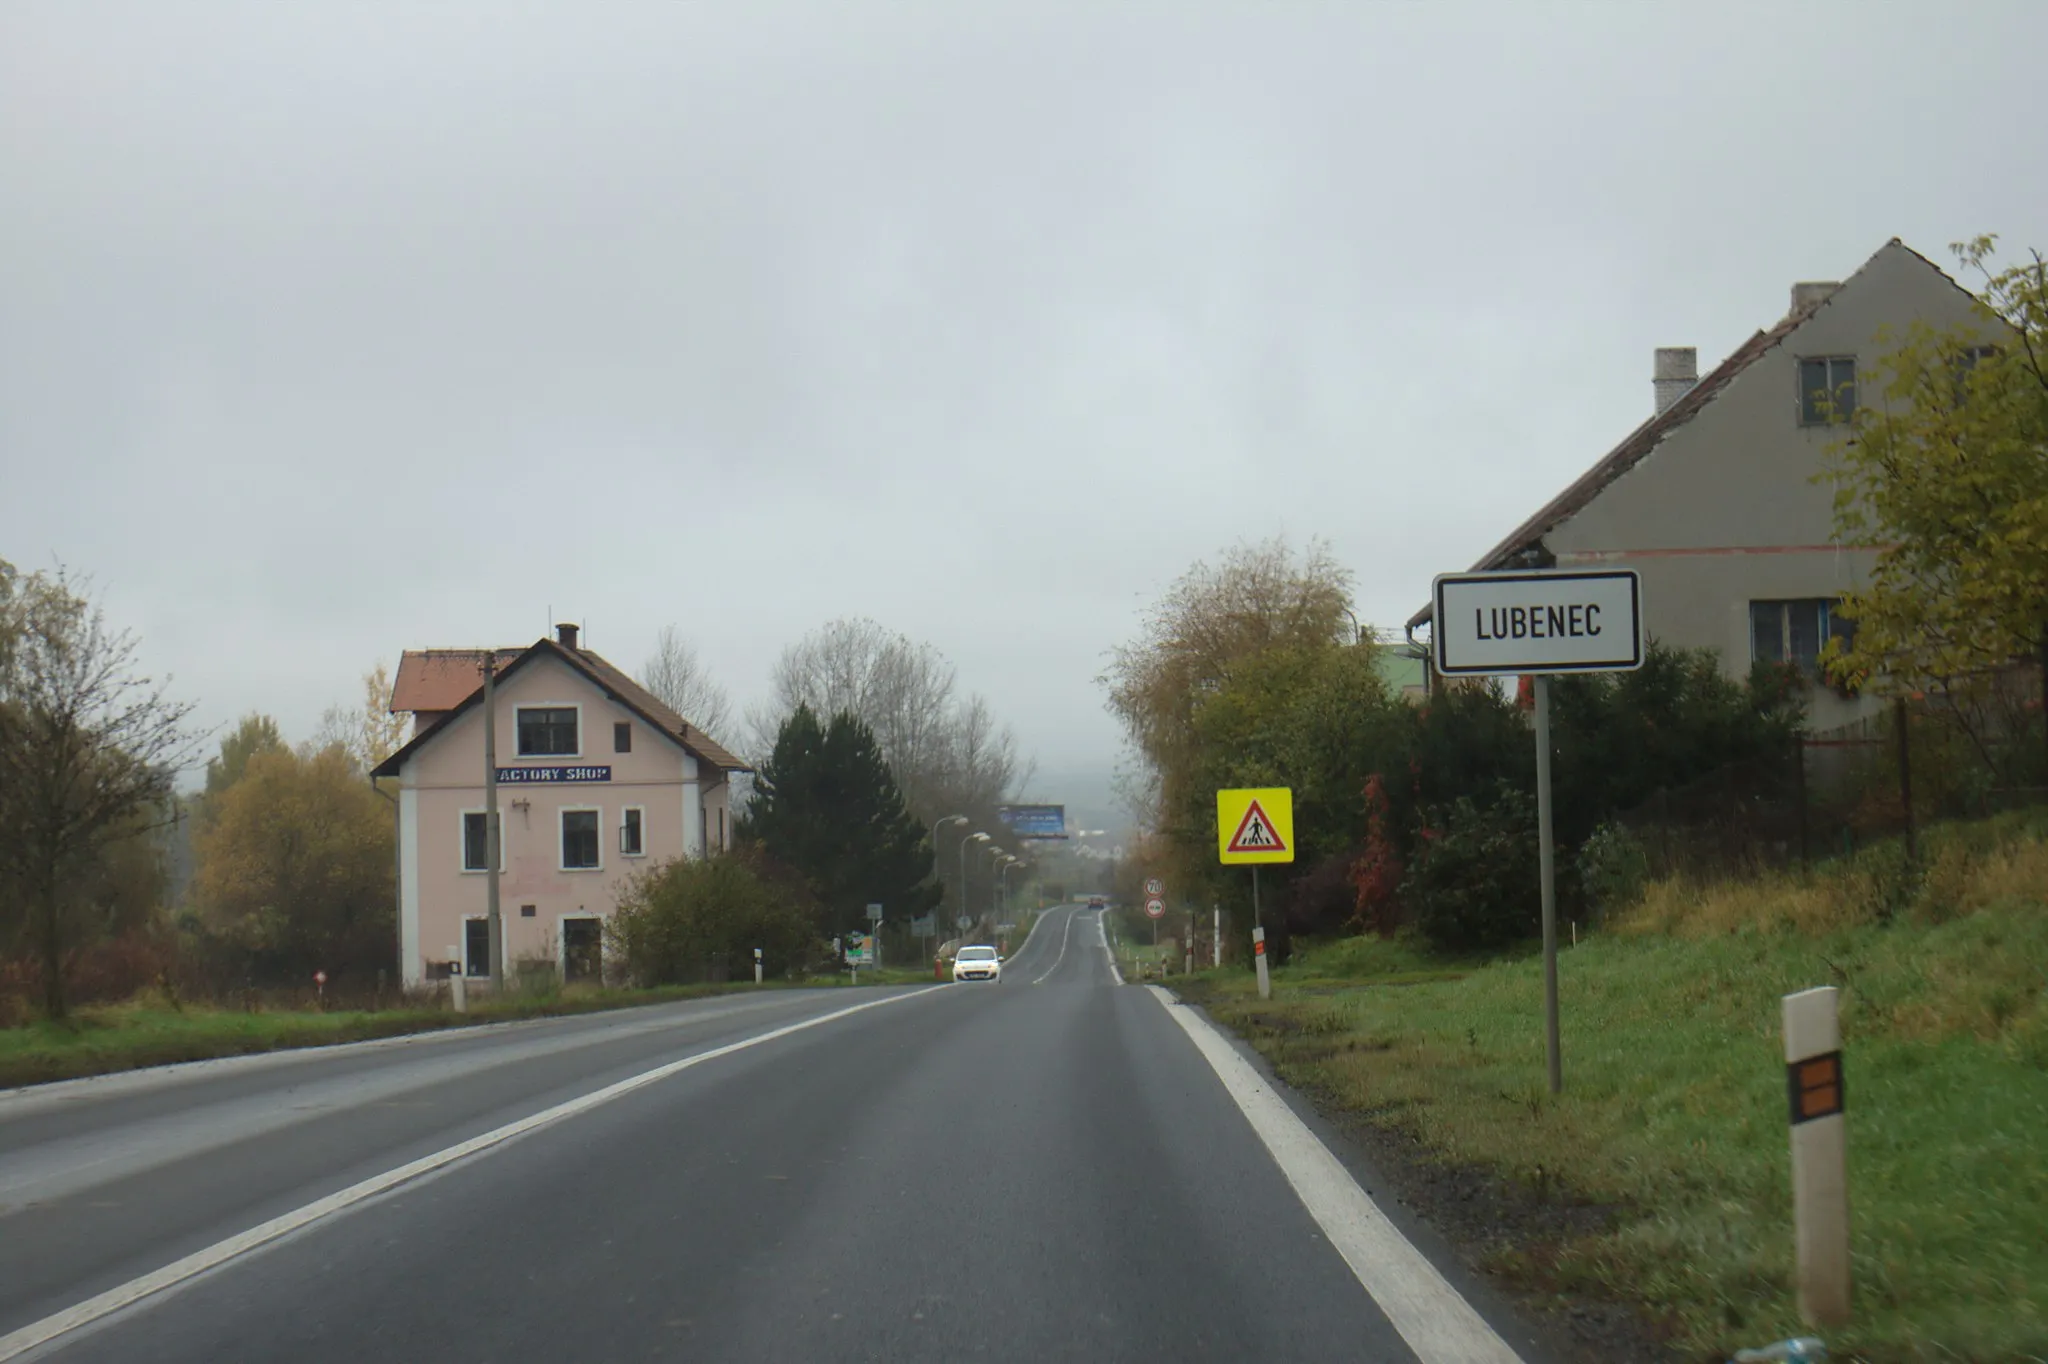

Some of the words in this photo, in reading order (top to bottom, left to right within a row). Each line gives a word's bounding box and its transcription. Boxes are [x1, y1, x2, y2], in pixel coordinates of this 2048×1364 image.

[1476, 603, 1602, 640] LUBENEC
[497, 768, 561, 781] ACTORY
[566, 768, 607, 780] SHOP
